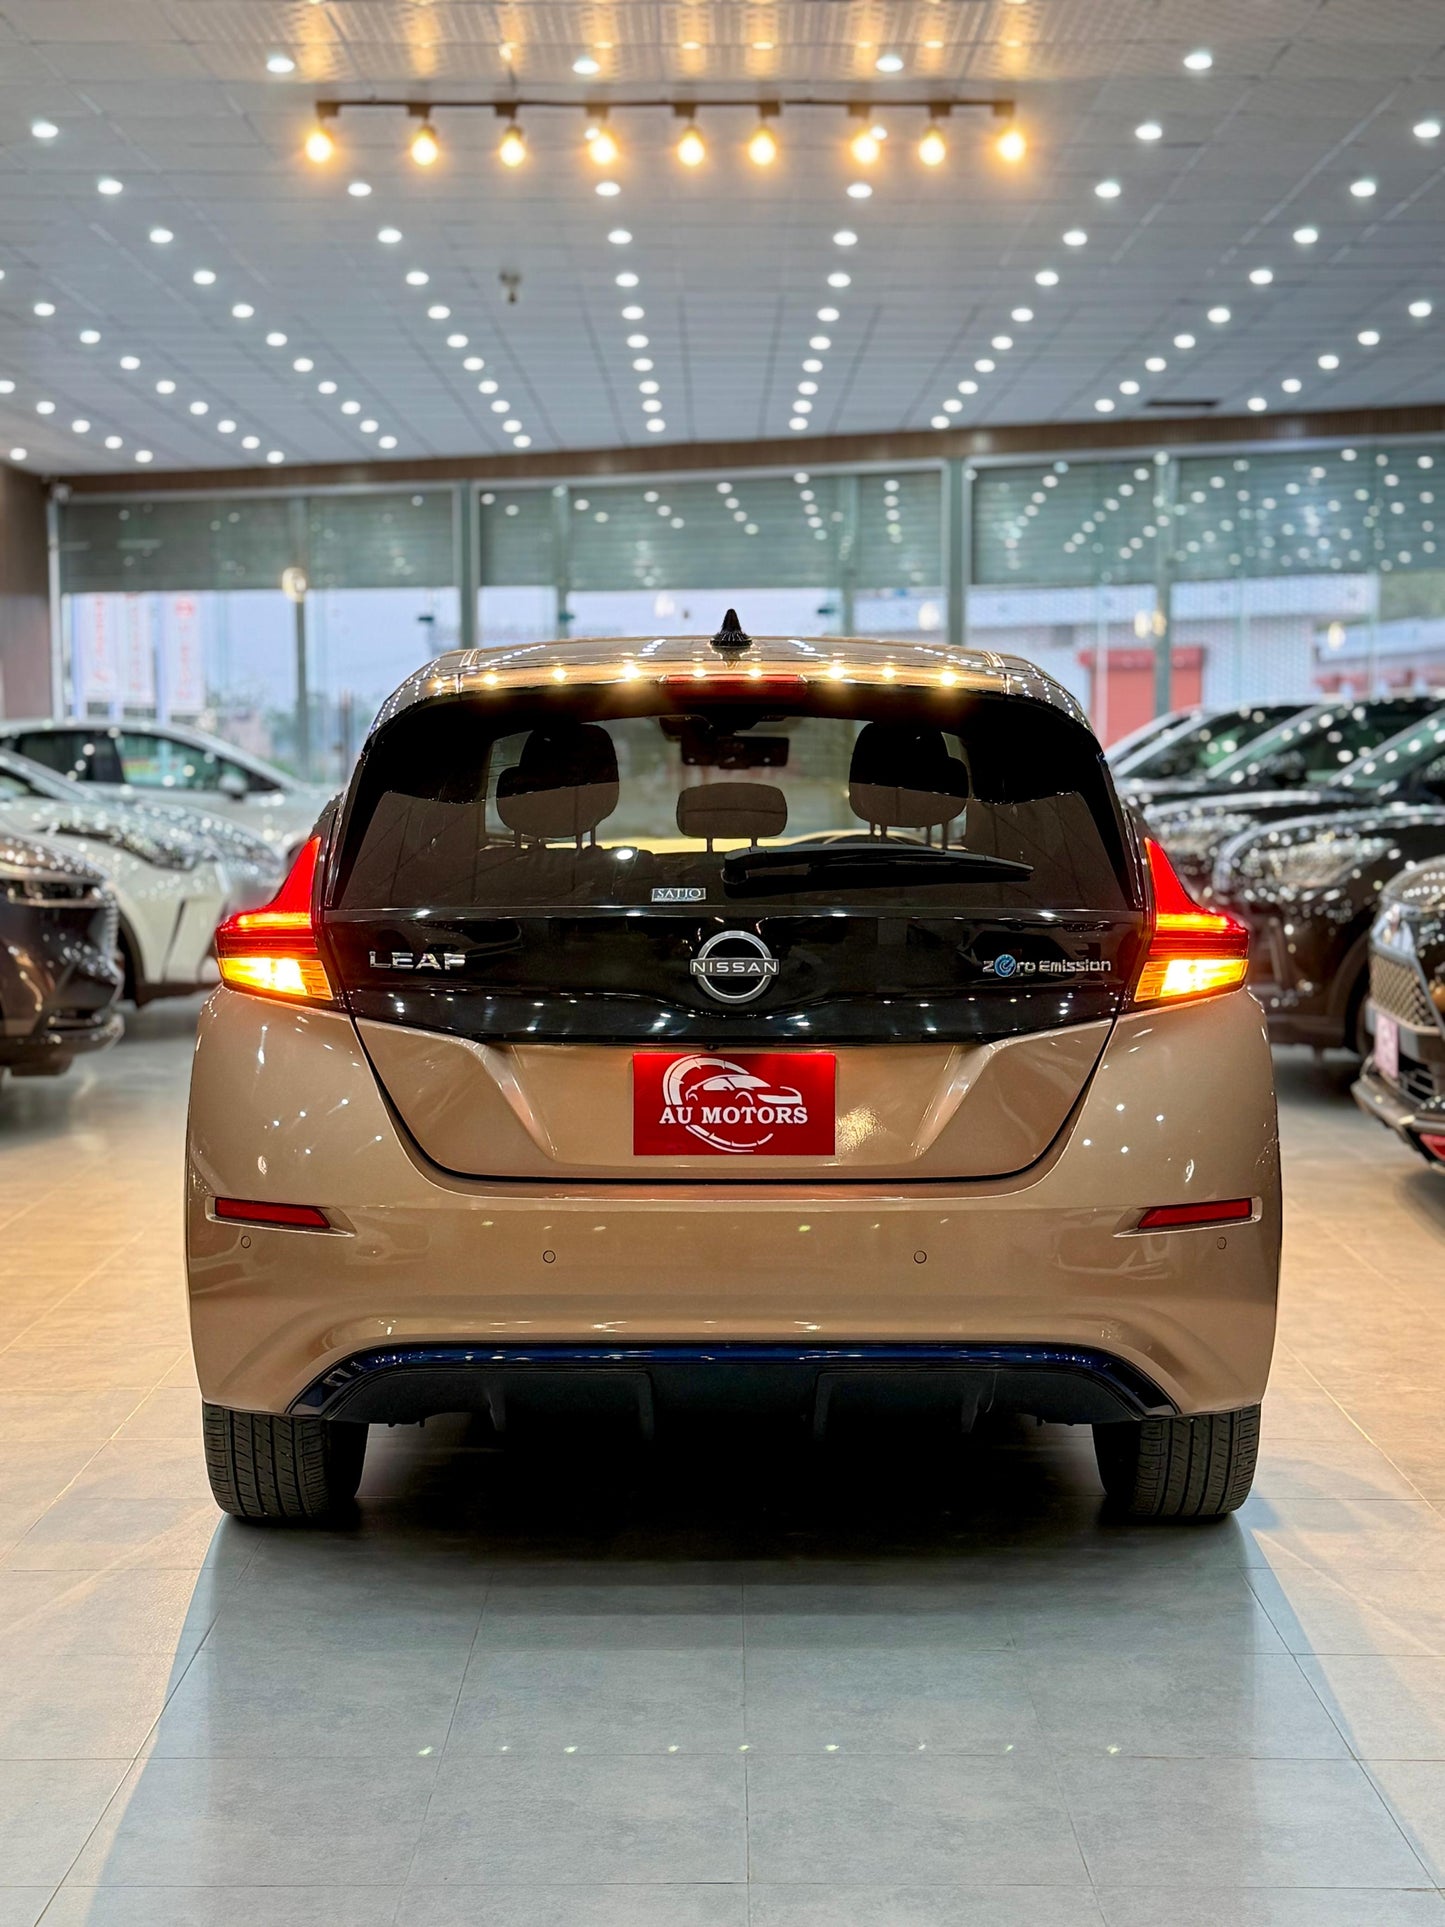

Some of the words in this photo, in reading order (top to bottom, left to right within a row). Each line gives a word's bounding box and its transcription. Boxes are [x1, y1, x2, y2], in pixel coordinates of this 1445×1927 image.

[369, 951, 466, 970] LEAF
[692, 961, 777, 973] NISSAN
[1038, 959, 1112, 973] Emission
[659, 1106, 693, 1124] AU
[701, 1106, 808, 1124] MOTORS
